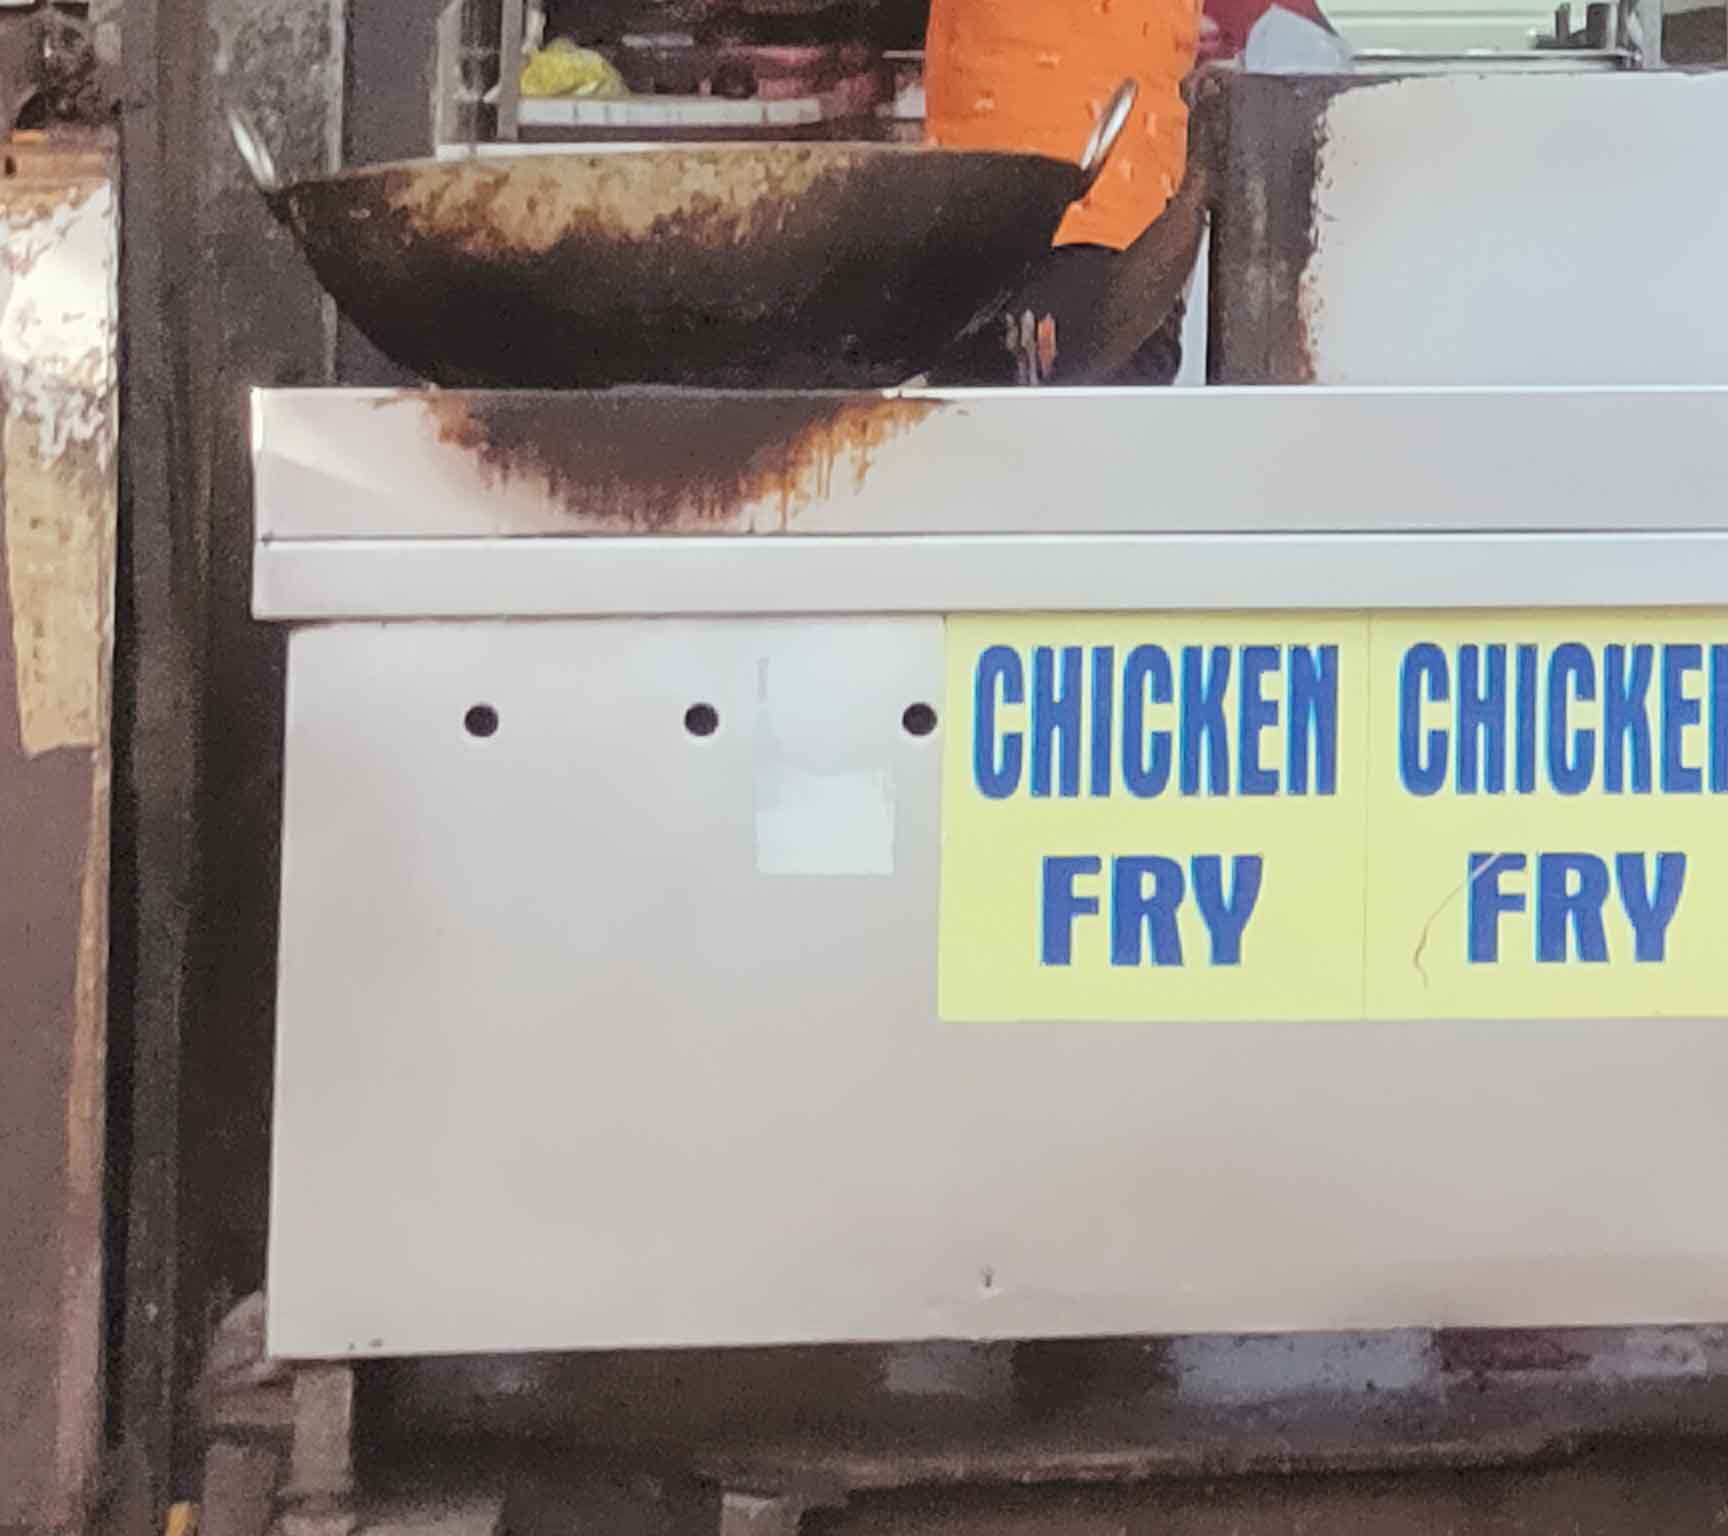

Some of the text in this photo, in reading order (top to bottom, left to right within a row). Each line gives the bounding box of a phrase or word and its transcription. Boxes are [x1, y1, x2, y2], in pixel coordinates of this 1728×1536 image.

[972, 645, 1338, 799] CHICKEN
[1040, 854, 1263, 966] FRY
[1466, 852, 1687, 963] FRY
